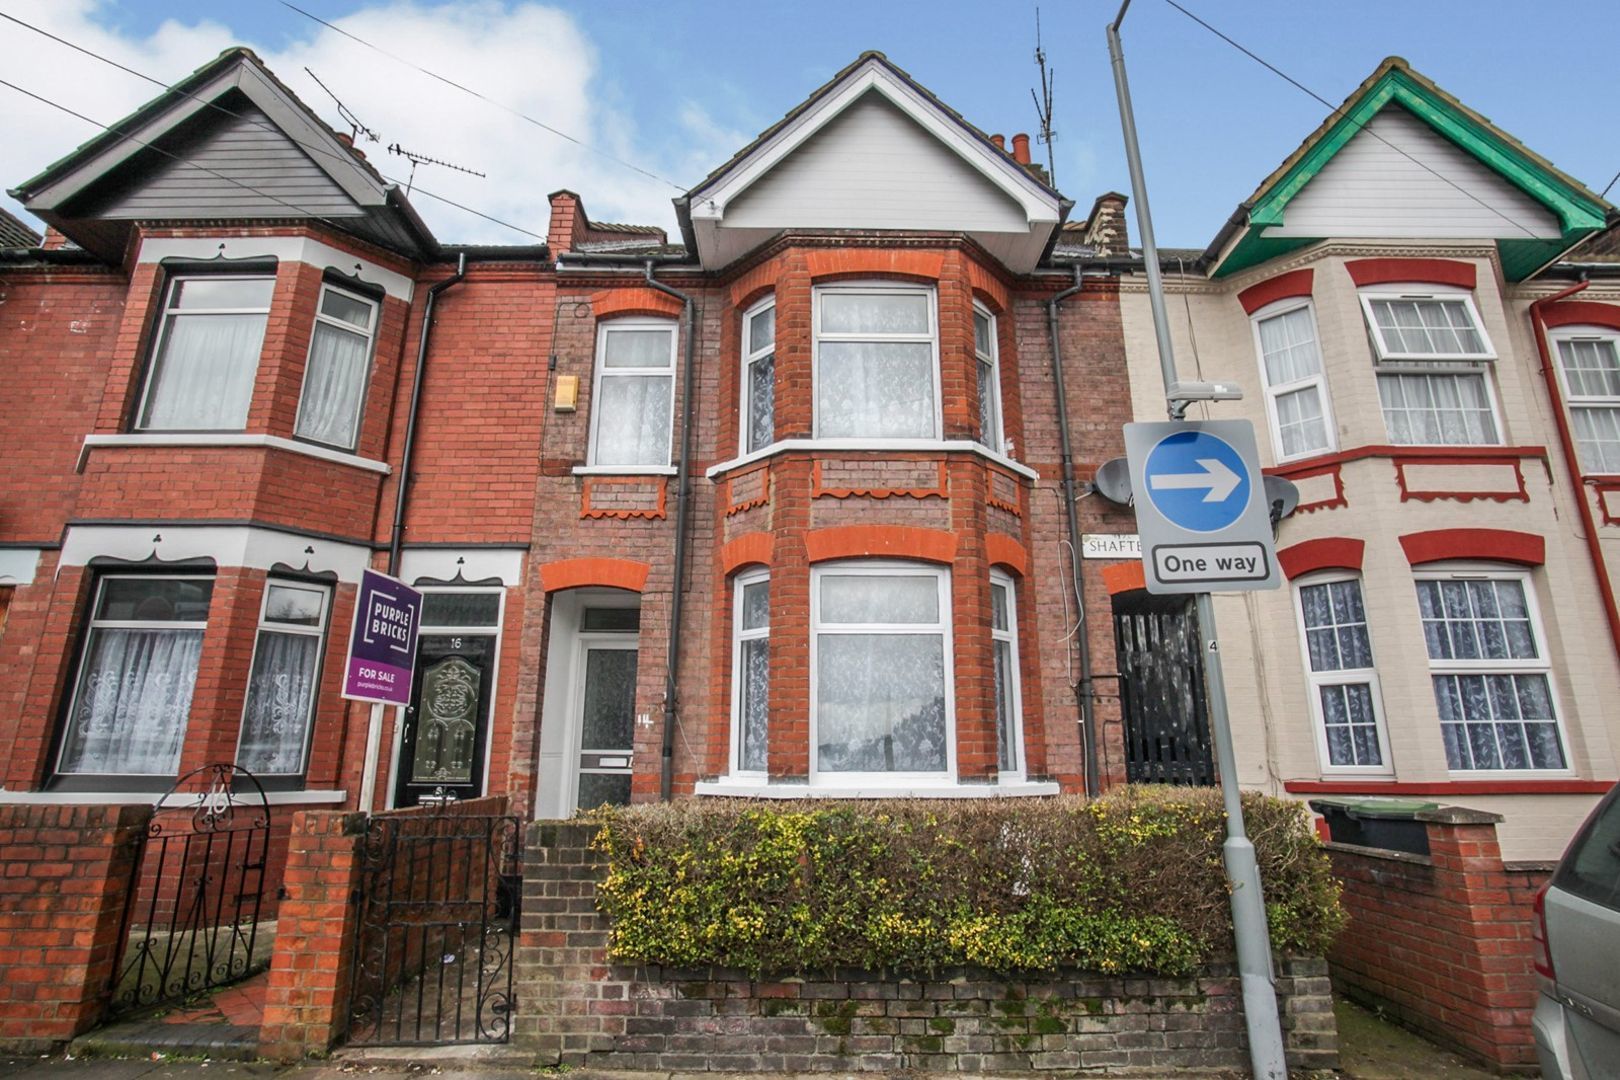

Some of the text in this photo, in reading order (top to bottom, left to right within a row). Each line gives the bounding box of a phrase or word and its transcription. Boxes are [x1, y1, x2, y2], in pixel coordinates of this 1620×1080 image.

[1164, 555, 1256, 573] One way
[374, 602, 409, 626] PURPLE
[372, 618, 407, 642] BRICKS
[451, 637, 462, 649] 16
[1210, 641, 1217, 651] 4
[358, 667, 395, 683] FOR SALE
[637, 714, 654, 728] 14
